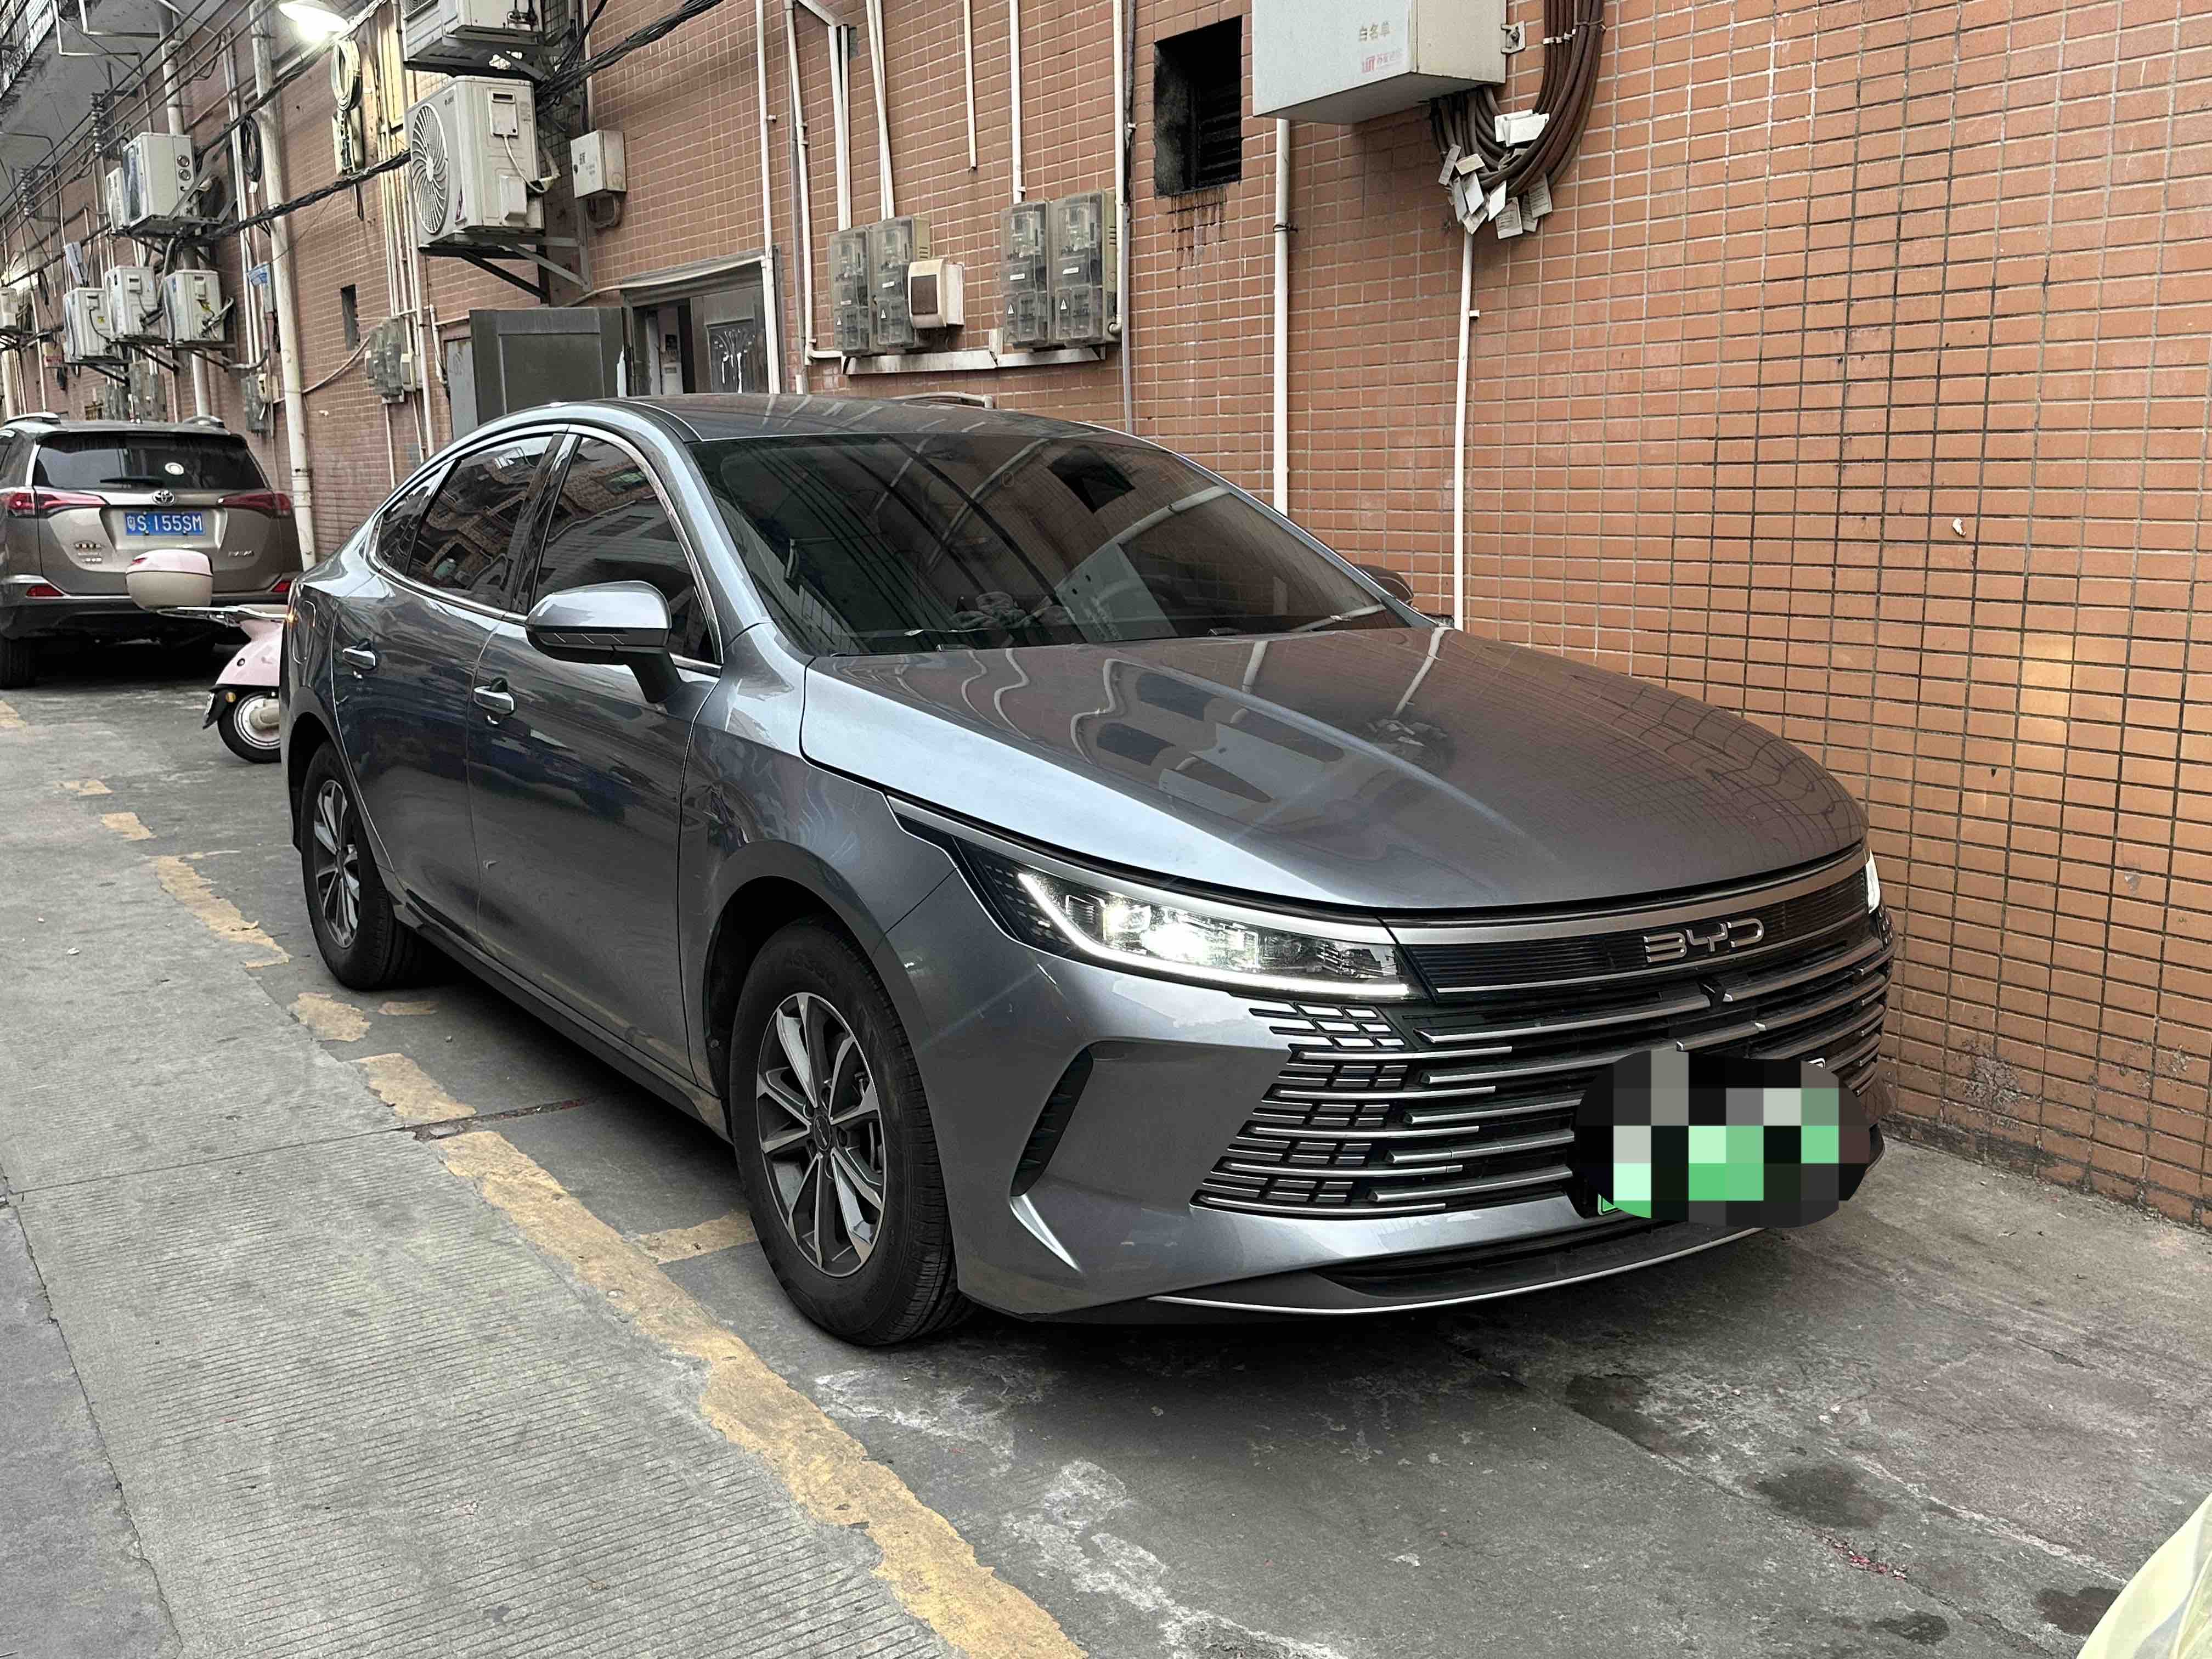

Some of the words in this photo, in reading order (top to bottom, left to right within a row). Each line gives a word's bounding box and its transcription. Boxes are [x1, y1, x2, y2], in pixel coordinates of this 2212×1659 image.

[1359, 21, 1391, 42] 白名单
[1643, 918, 1764, 963] BYD
